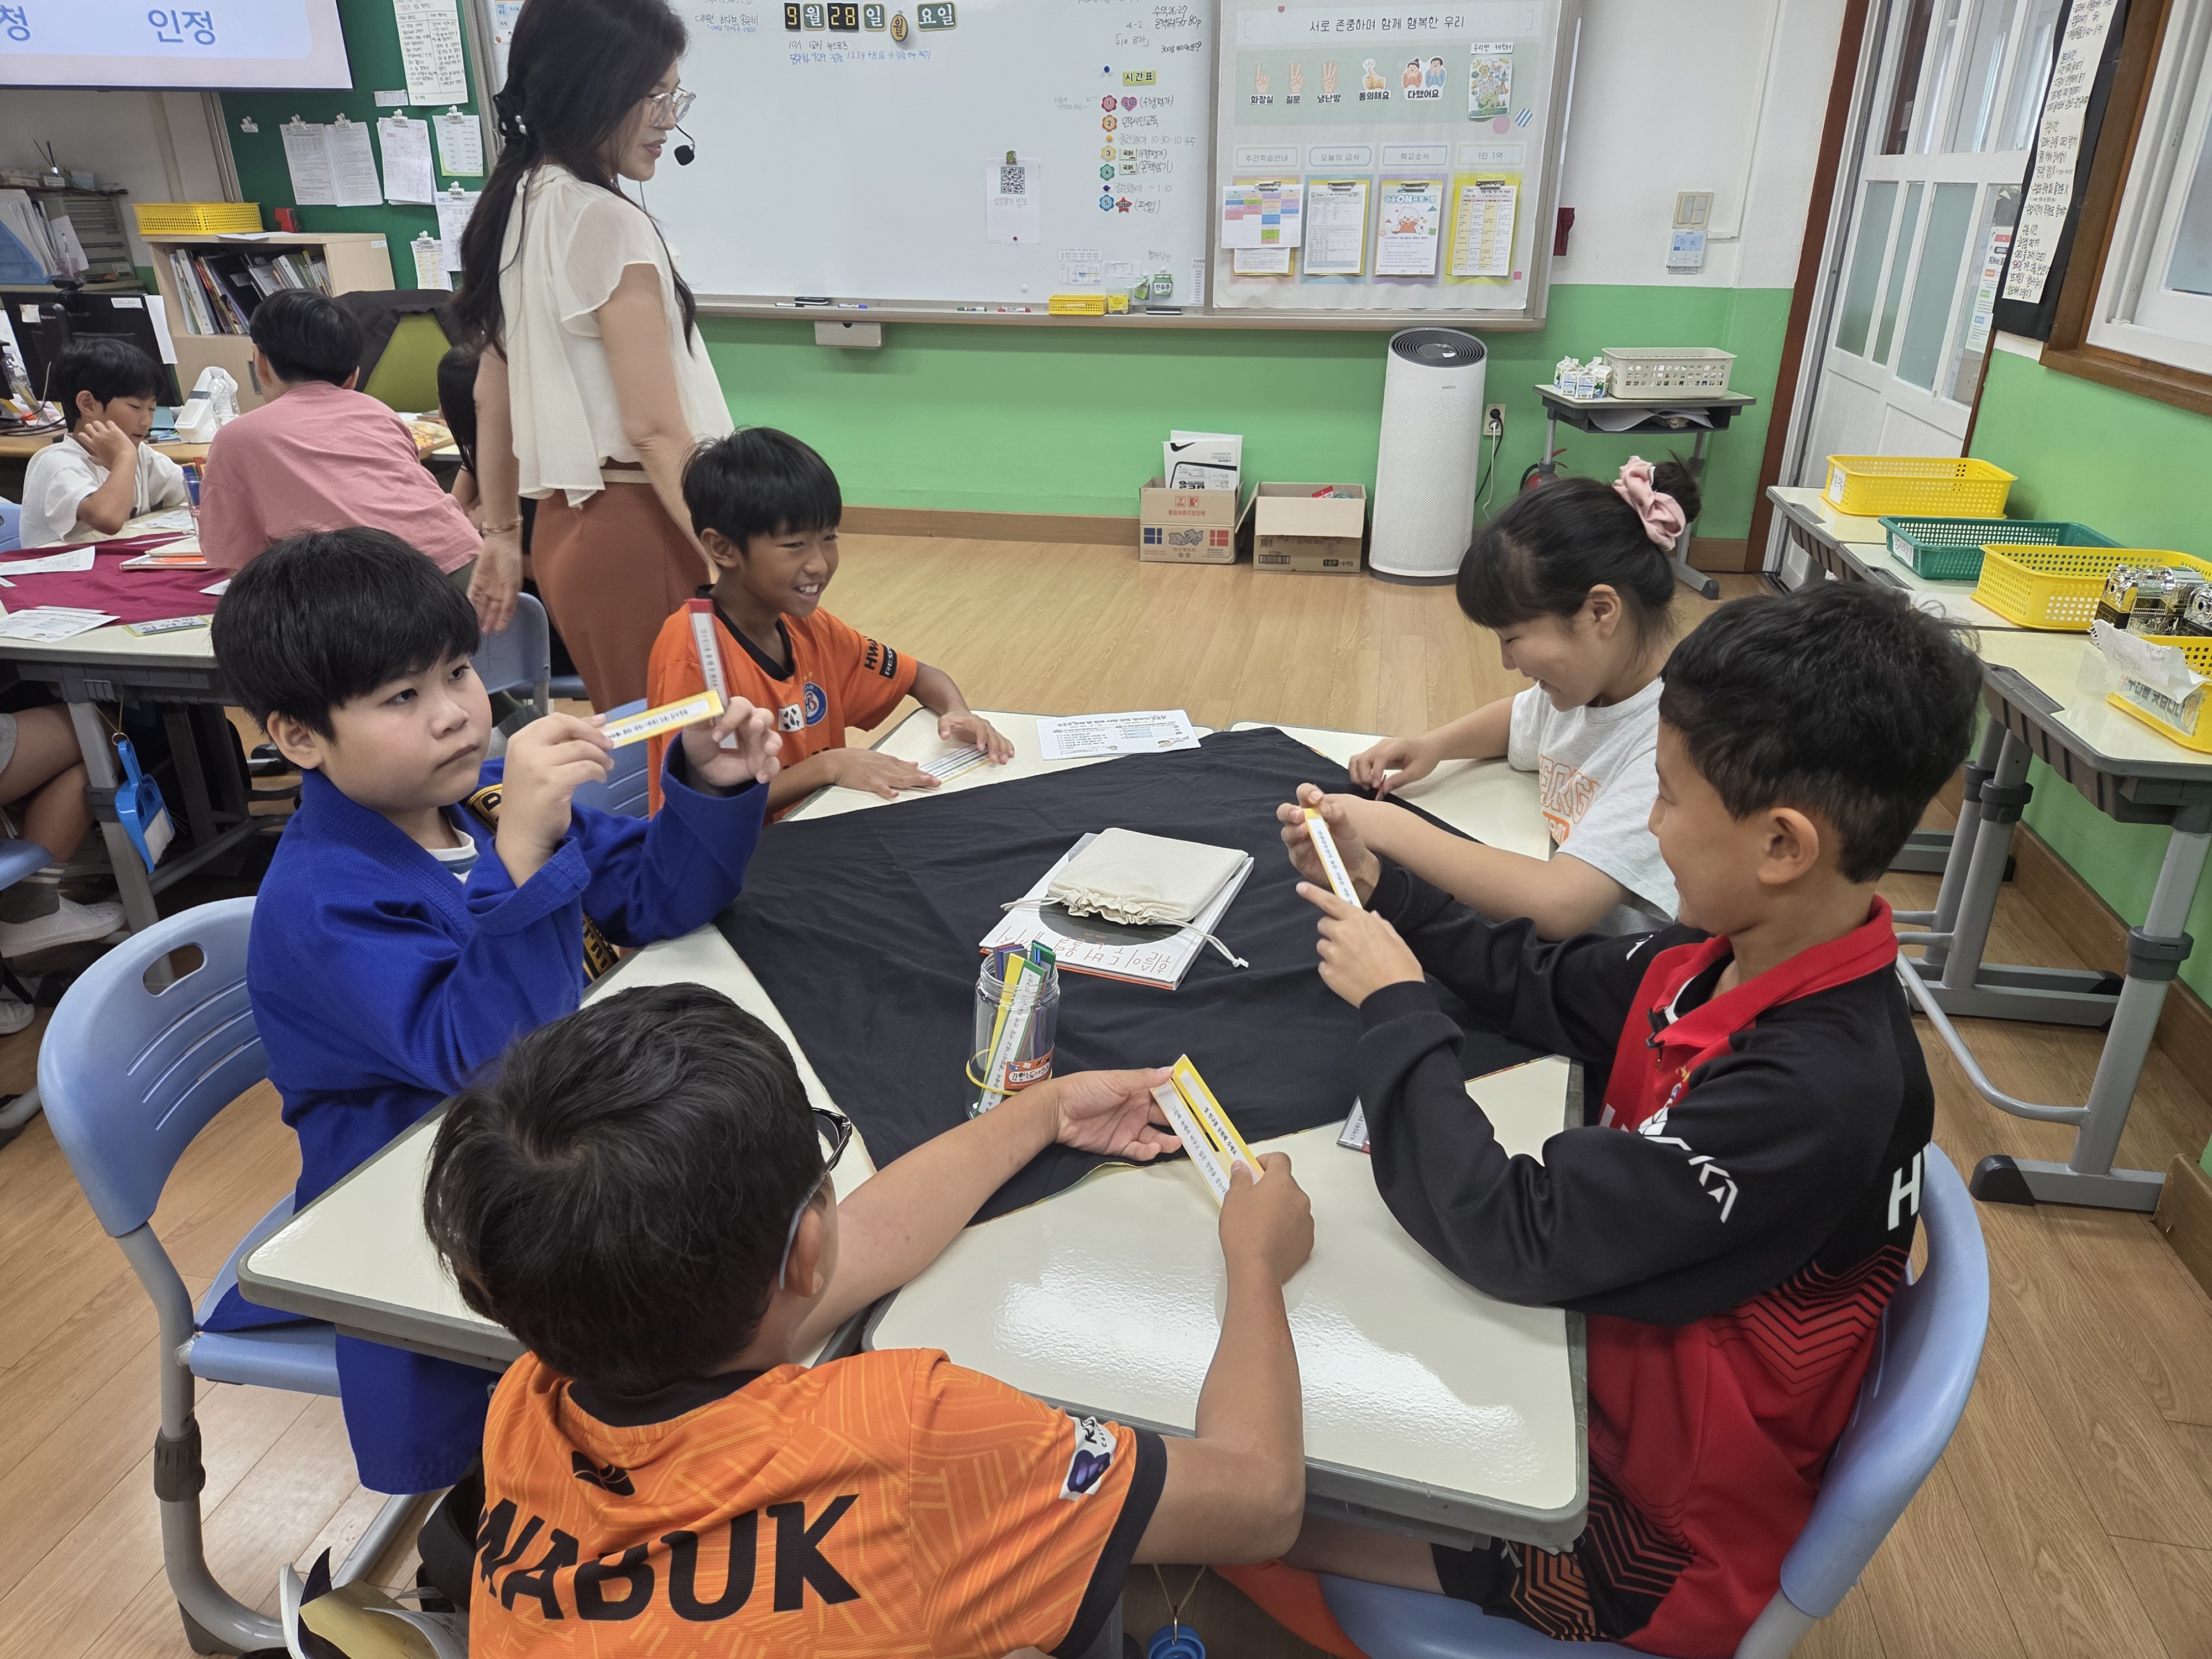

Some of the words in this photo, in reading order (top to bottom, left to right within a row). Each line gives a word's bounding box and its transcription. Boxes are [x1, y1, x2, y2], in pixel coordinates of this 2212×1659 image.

[787, 7, 797, 25] 9
[805, 6, 822, 27] 월
[831, 7, 855, 25] 28
[867, 6, 882, 27] 일
[919, 5, 955, 25] 요일
[148, 9, 216, 45] 인정
[1310, 20, 1331, 33] 서로
[1335, 19, 1376, 32] 존중하며
[1381, 18, 1402, 30] 함께
[1407, 17, 1438, 29] 행복한
[1444, 15, 1465, 28] 우리
[827, 41, 848, 51] 뉴스포츠
[1474, 44, 1490, 52] 우리반
[1494, 43, 1512, 51] 캐릭터
[1125, 72, 1153, 82] 시간표
[1317, 93, 1341, 103] 냉난방
[1358, 91, 1390, 102] 동의해요
[1407, 88, 1439, 100] 다했어요
[1250, 95, 1274, 105] 화장실
[1286, 95, 1301, 104] 질문
[1245, 154, 1288, 163] 주간학습안내
[1321, 153, 1342, 162] 오늘의
[1345, 153, 1360, 161] 급식
[1400, 152, 1430, 160] 학교소식
[1084, 941, 1105, 963] 번
[1107, 947, 1124, 966] 두
[1125, 949, 1171, 974] 휘슬이
[1190, 1135, 1201, 1151] 바꾸고
